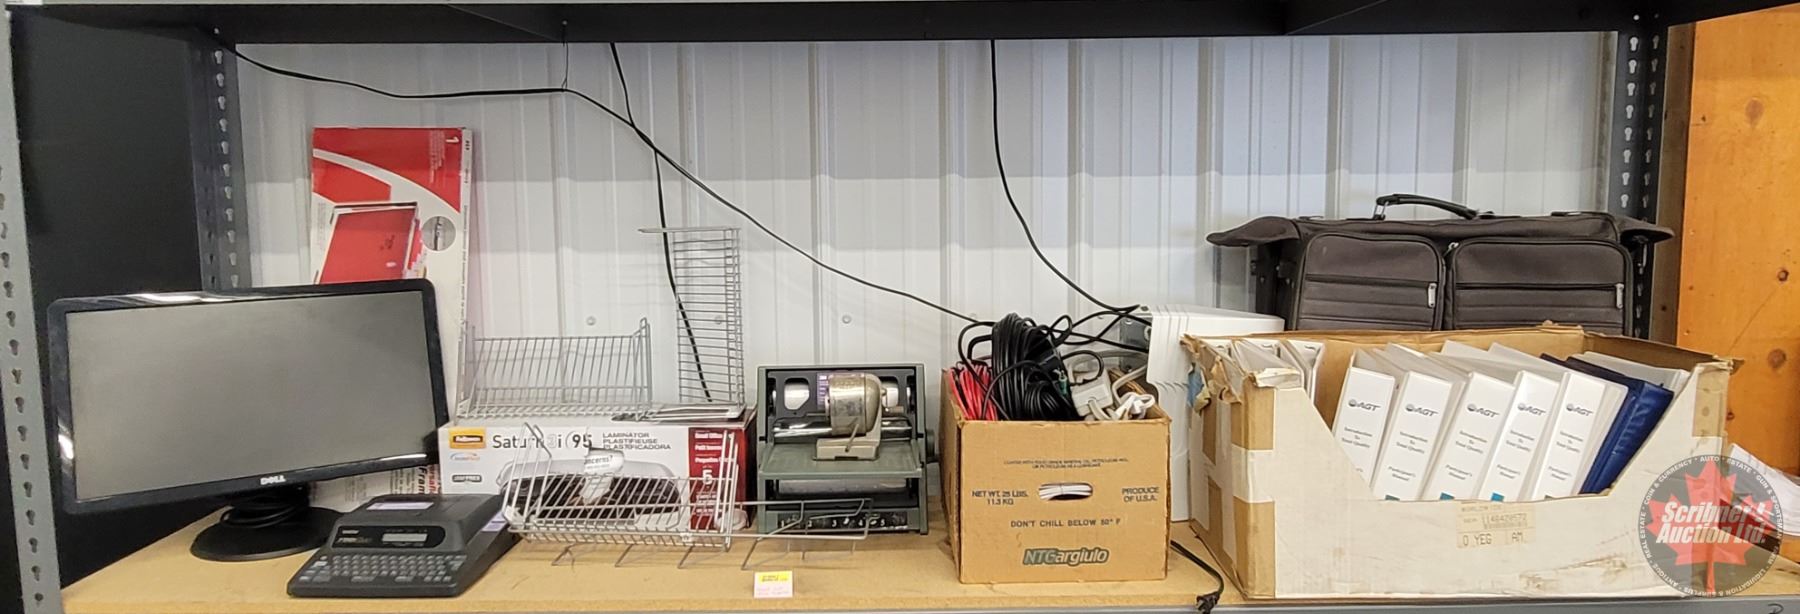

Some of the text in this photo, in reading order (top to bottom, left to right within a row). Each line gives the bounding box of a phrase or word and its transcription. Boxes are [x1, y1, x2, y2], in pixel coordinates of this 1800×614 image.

[1357, 402, 1381, 412] AGT
[1415, 407, 1438, 417] AGT
[1525, 406, 1546, 416] AGT
[1573, 407, 1594, 416] AGT
[1476, 408, 1500, 418] AGT
[260, 475, 286, 485] DELL
[972, 490, 986, 498] NET
[1010, 520, 1035, 528] DON'T
[1040, 520, 1063, 528] CHILL
[1068, 519, 1096, 527] BELOW
[1023, 547, 1109, 566] NTGargiulo
